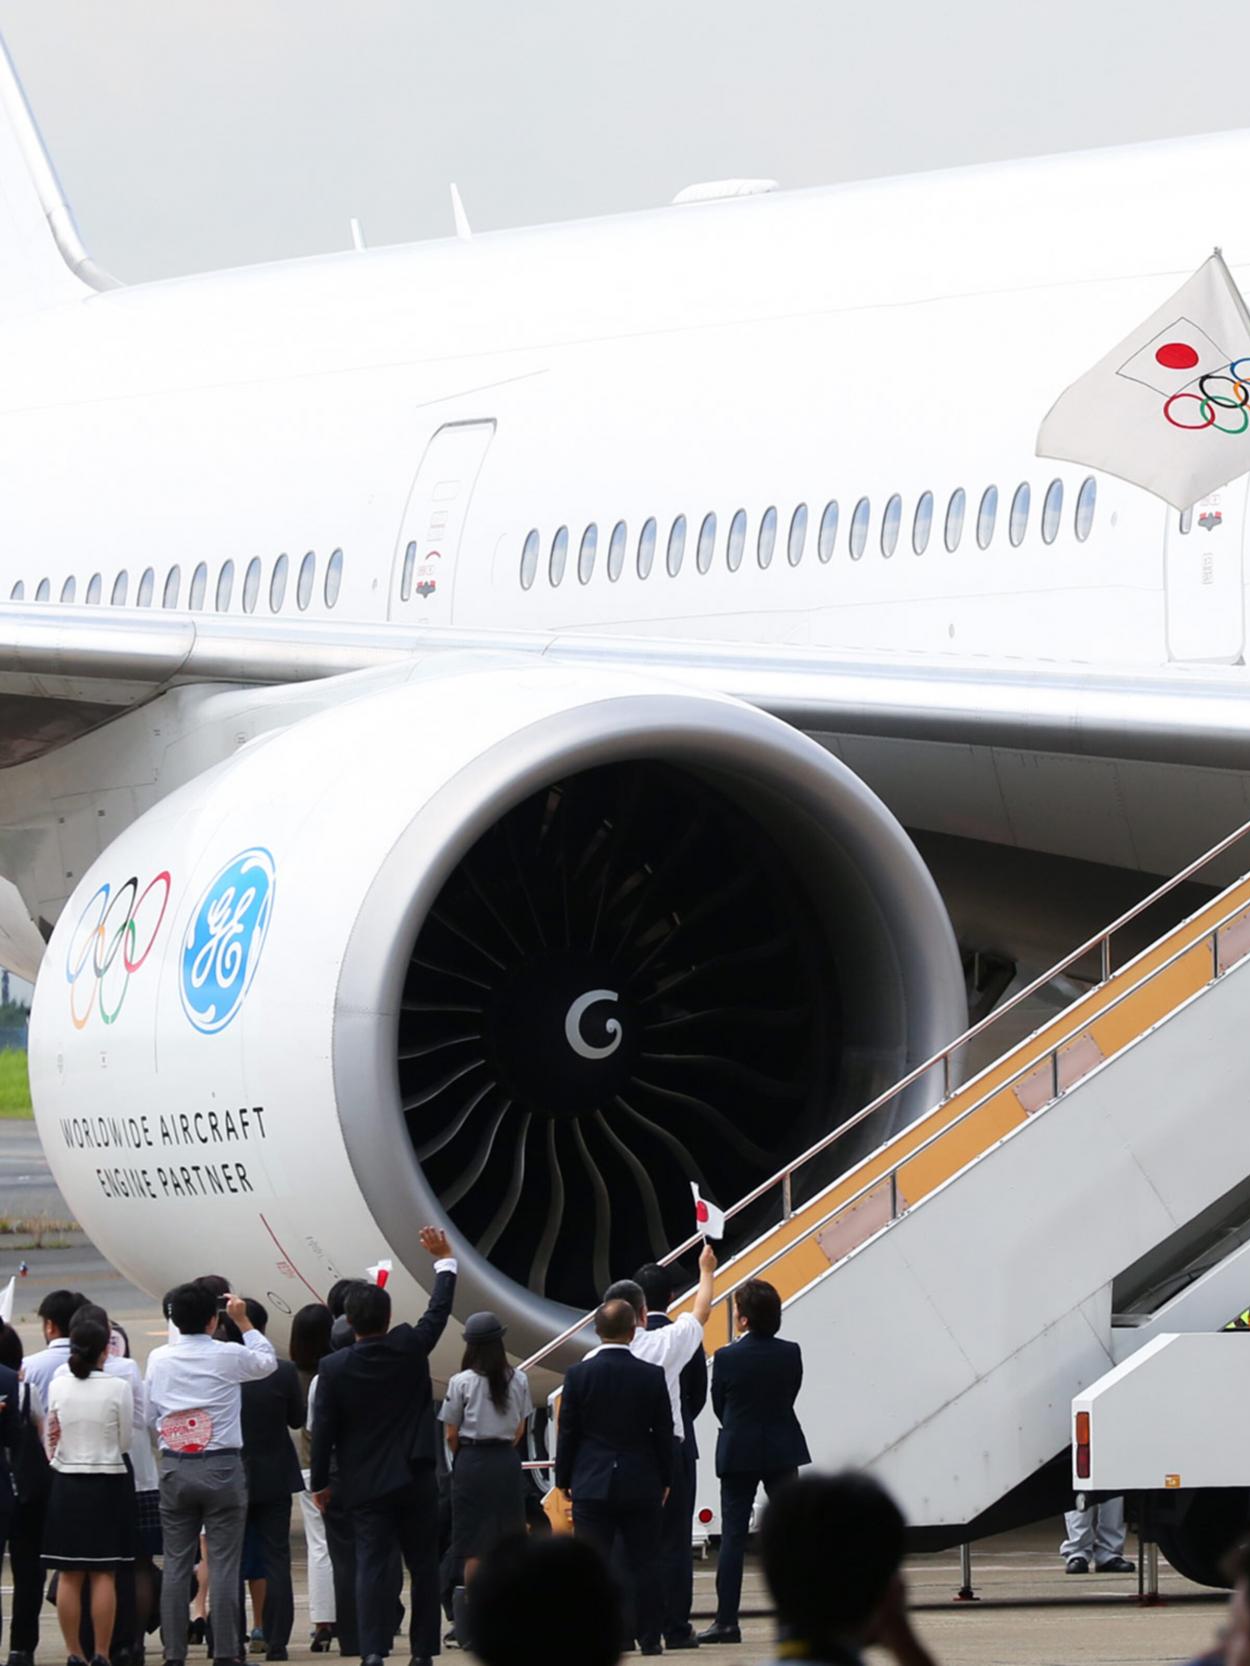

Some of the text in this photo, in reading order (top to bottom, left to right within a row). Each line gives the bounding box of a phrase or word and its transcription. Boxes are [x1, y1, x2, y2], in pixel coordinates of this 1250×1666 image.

[59, 1107, 267, 1149] WORLDWIDE AIRCRAFT
[96, 1162, 254, 1199] ENGINE PARTNER
